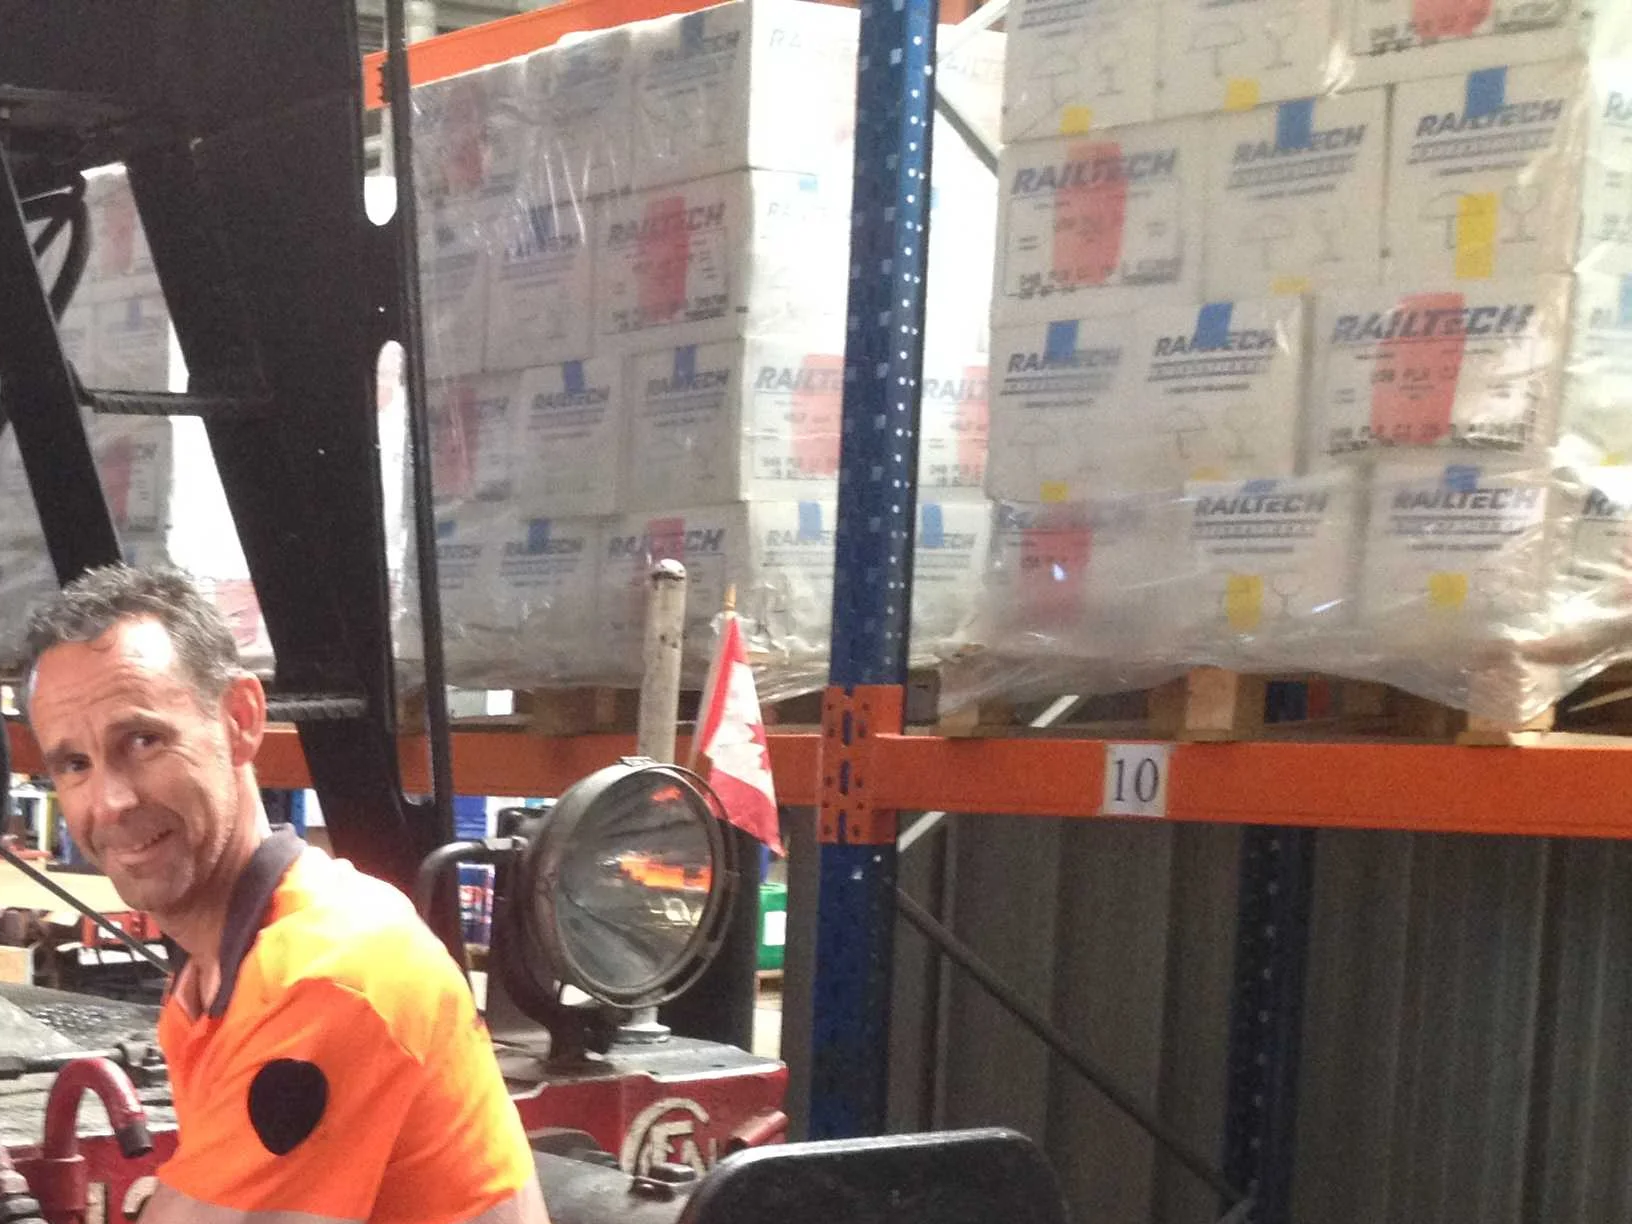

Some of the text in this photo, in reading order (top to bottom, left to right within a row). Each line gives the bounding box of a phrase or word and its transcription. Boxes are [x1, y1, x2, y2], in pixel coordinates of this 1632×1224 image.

[1231, 124, 1366, 166] RATECH
[1331, 304, 1535, 344] RAILTECH
[1193, 489, 1330, 517] RAILTECH
[1390, 486, 1539, 511] RAILTECH
[1113, 757, 1160, 803] 10
